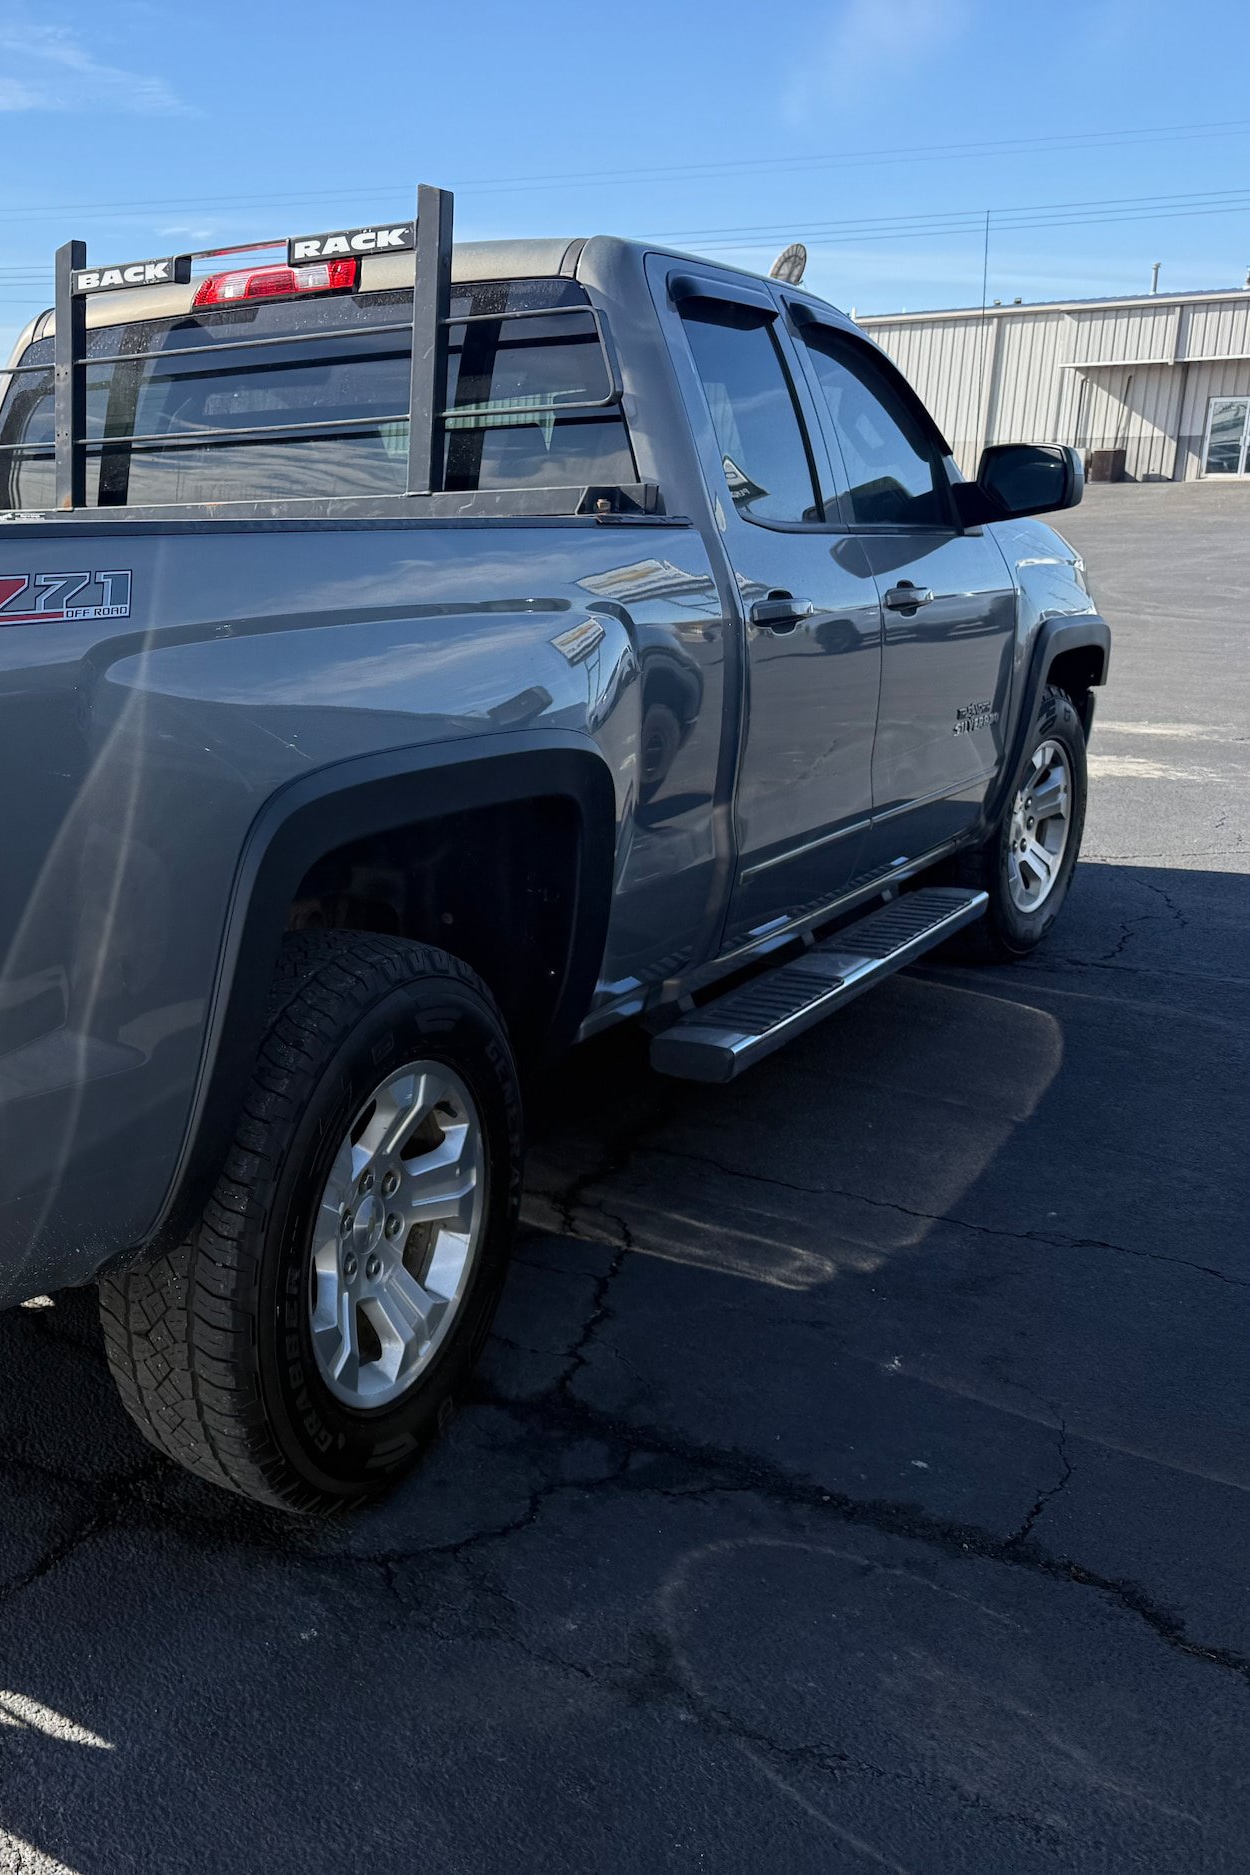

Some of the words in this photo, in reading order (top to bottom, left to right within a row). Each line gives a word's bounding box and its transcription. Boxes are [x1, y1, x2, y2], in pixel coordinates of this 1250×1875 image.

[77, 261, 169, 290] BACK
[294, 227, 407, 259] RACK
[66, 609, 90, 618] OFF
[94, 606, 127, 616] ROAD
